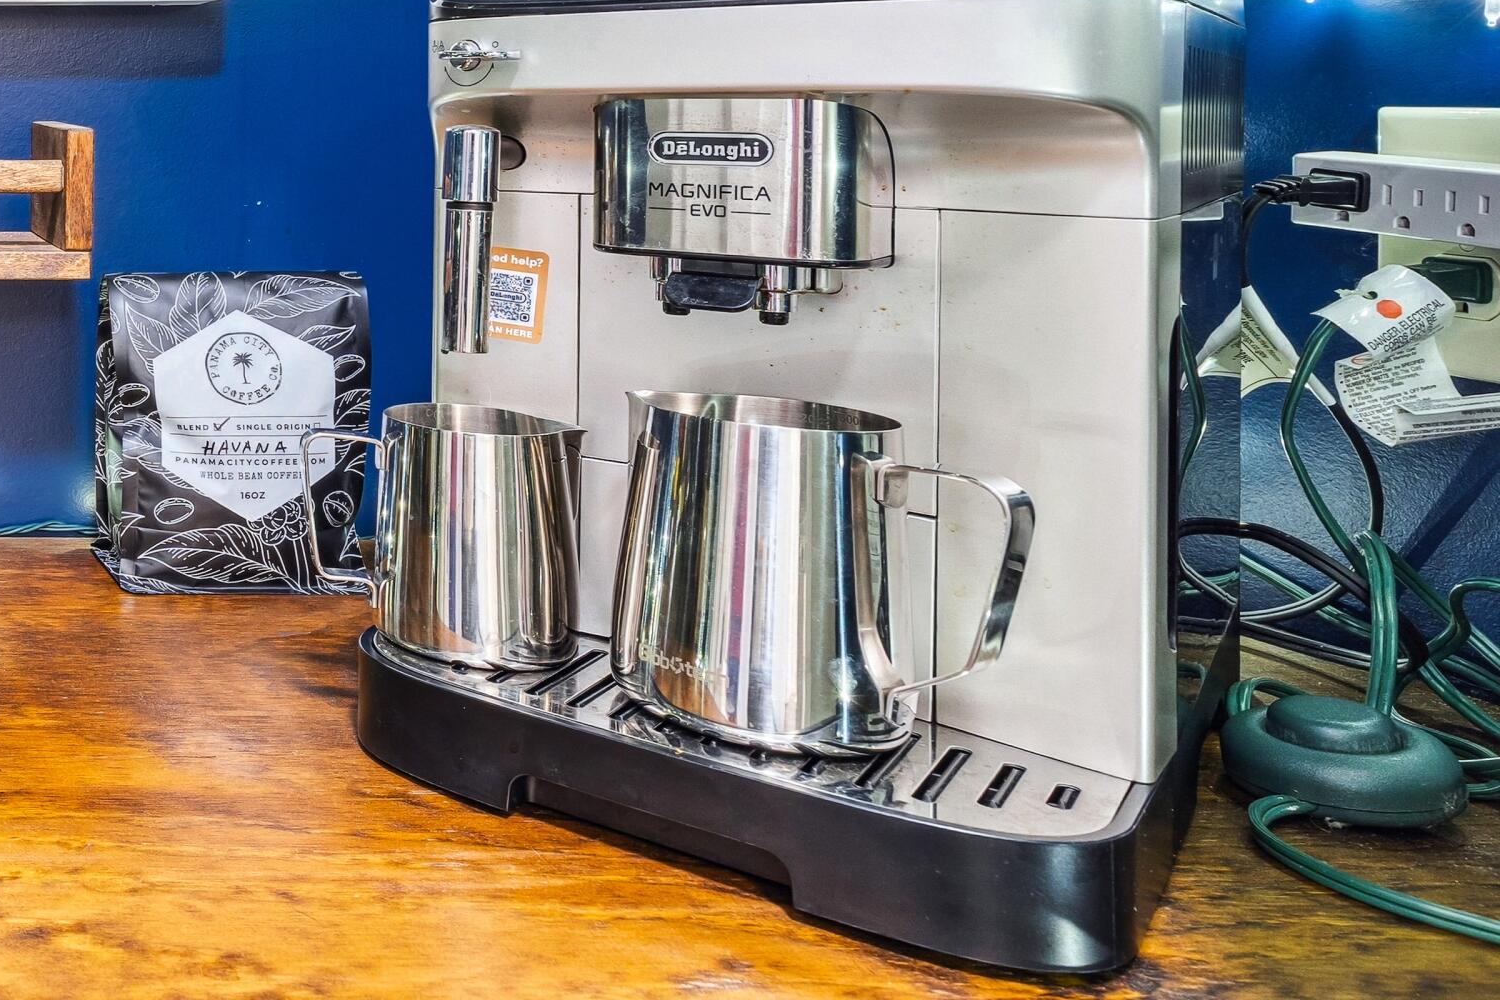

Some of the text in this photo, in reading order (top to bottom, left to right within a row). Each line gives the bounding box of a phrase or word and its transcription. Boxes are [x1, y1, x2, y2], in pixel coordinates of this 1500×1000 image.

[648, 182, 772, 202] MAGNIFICA
[690, 203, 727, 218] EVO
[491, 253, 544, 269] ed help?
[1398, 299, 1446, 331] ELECTRICAL
[488, 325, 533, 339] AN HERE
[1383, 332, 1409, 352] CORDS
[1409, 321, 1426, 336] CAN
[1426, 313, 1438, 325] BE
[209, 336, 274, 379] PANAMA CITY
[1372, 372, 1390, 381] WATTS
[222, 384, 271, 401] COFFEE
[1380, 393, 1402, 401] Appliance
[201, 439, 288, 456] HAVANA
[175, 456, 326, 466] PANAMACITYCOFFEEOM
[200, 471, 234, 480] WHOLE
[238, 471, 263, 480] BEAN
[240, 491, 266, 499] 16OZ
